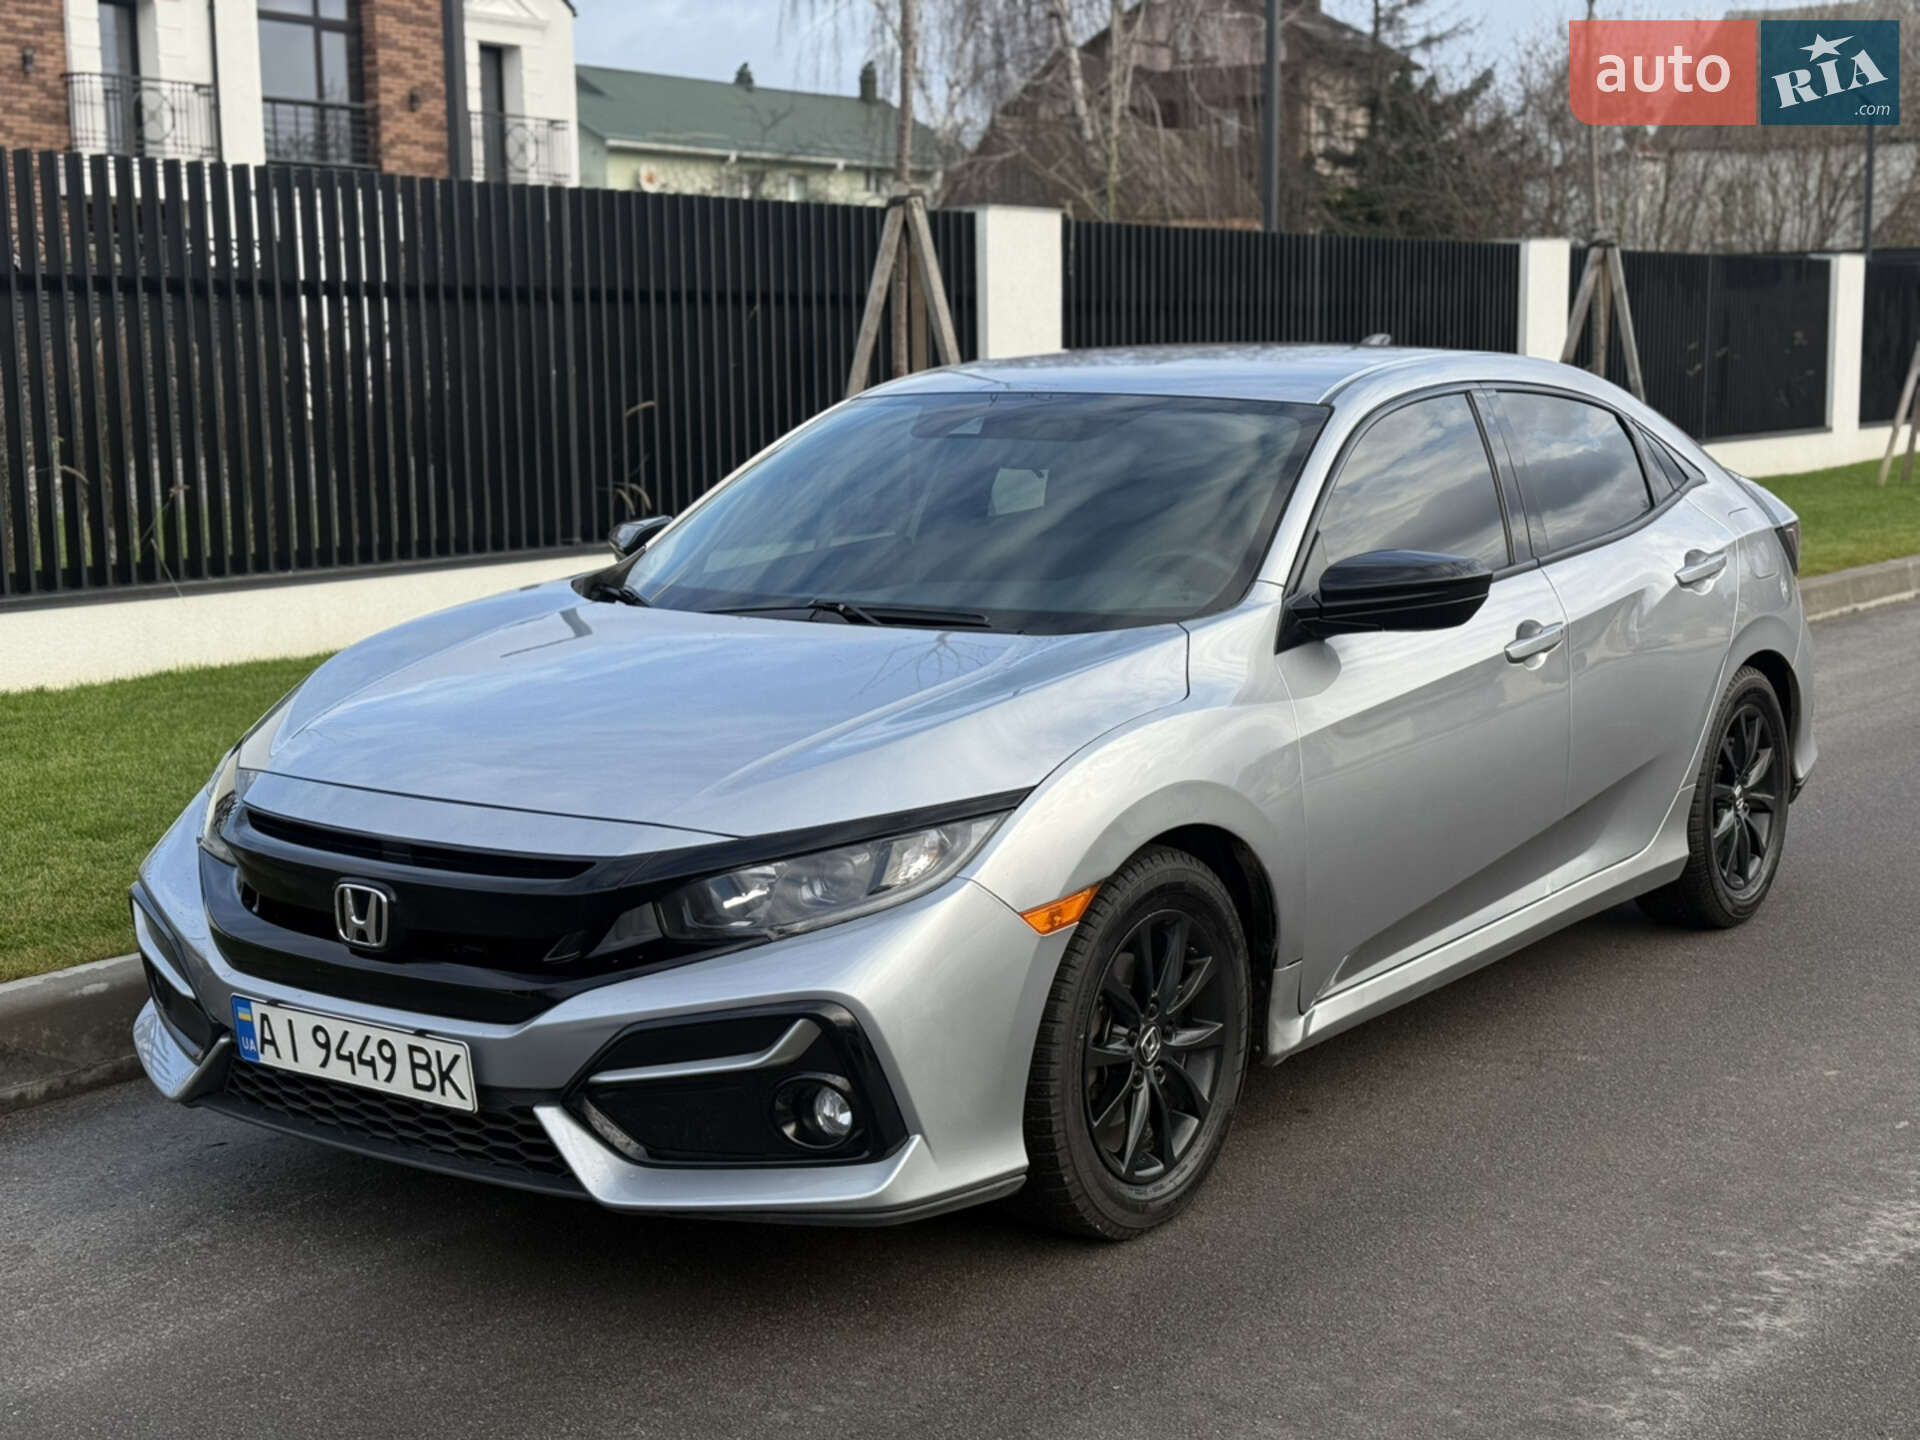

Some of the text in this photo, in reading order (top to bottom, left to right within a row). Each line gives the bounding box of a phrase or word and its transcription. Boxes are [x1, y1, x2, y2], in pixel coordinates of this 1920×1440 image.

[241, 1035, 257, 1052] UA
[260, 1012, 468, 1101] AI 9449 BK
